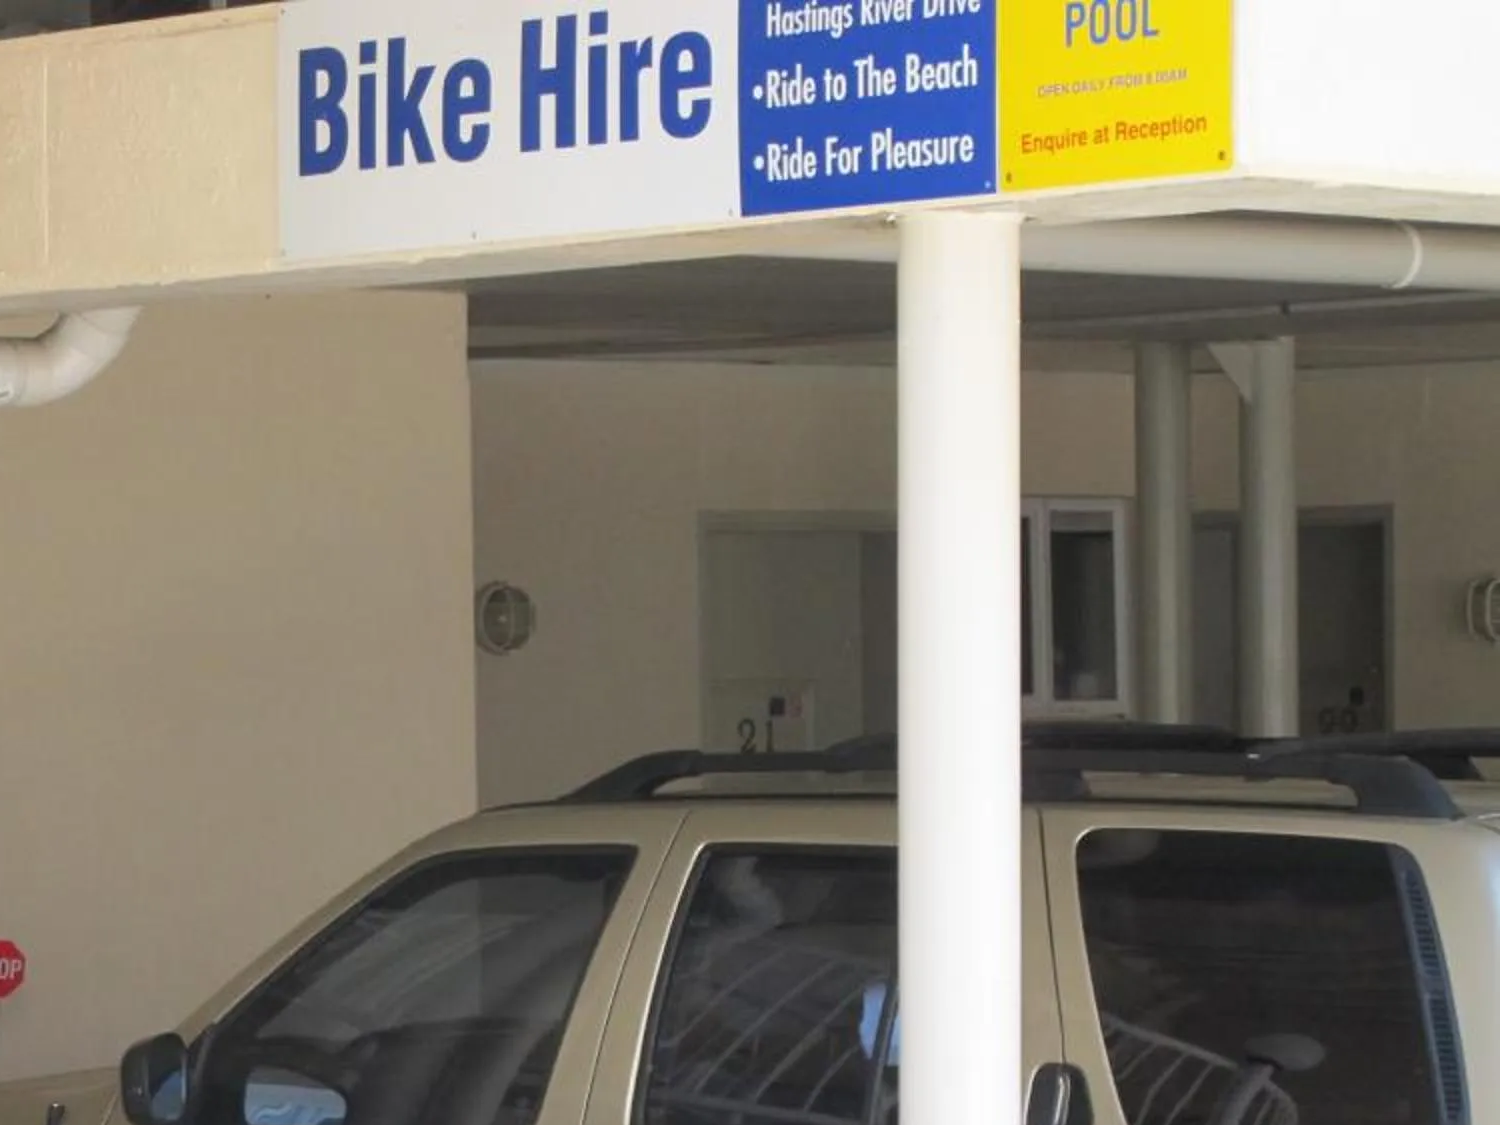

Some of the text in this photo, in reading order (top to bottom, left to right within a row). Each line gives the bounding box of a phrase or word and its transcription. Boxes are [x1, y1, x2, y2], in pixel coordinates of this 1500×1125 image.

[766, 1, 853, 39] Hastings
[860, 0, 913, 26] River
[1064, 0, 1160, 49] POOL
[298, 9, 713, 178] Bike Hire
[824, 68, 847, 103] to
[853, 53, 897, 99] The
[904, 43, 979, 94] Beach
[825, 136, 863, 177] For
[870, 127, 975, 172] Pleasure
[1019, 114, 1208, 157] Enquire at Reception
